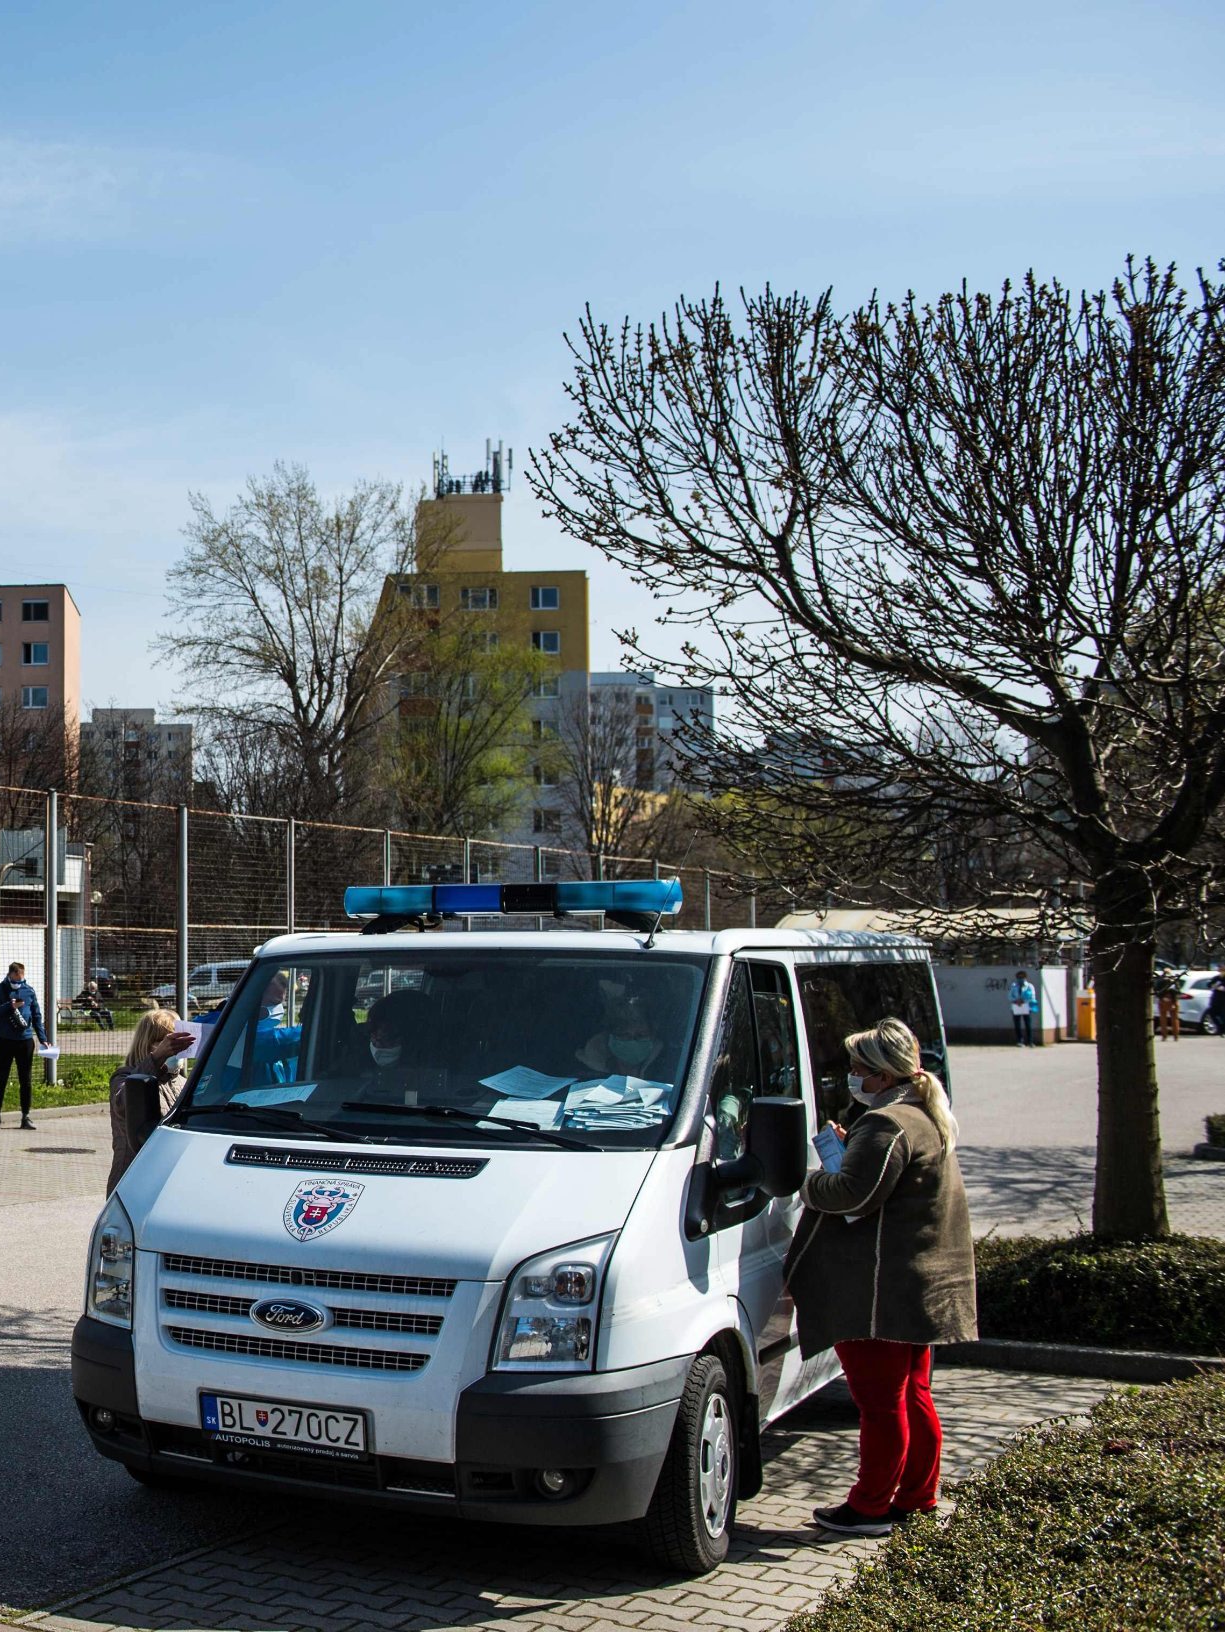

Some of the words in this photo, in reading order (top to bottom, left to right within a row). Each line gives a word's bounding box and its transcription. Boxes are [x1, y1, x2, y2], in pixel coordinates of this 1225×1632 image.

[317, 1203, 354, 1235] REPUBLIKA
[265, 1304, 304, 1325] Ford
[206, 1416, 217, 1425] SK
[215, 1433, 271, 1448] AUTOPOLIS
[315, 1448, 335, 1457] predaj
[340, 1452, 359, 1460] servis
